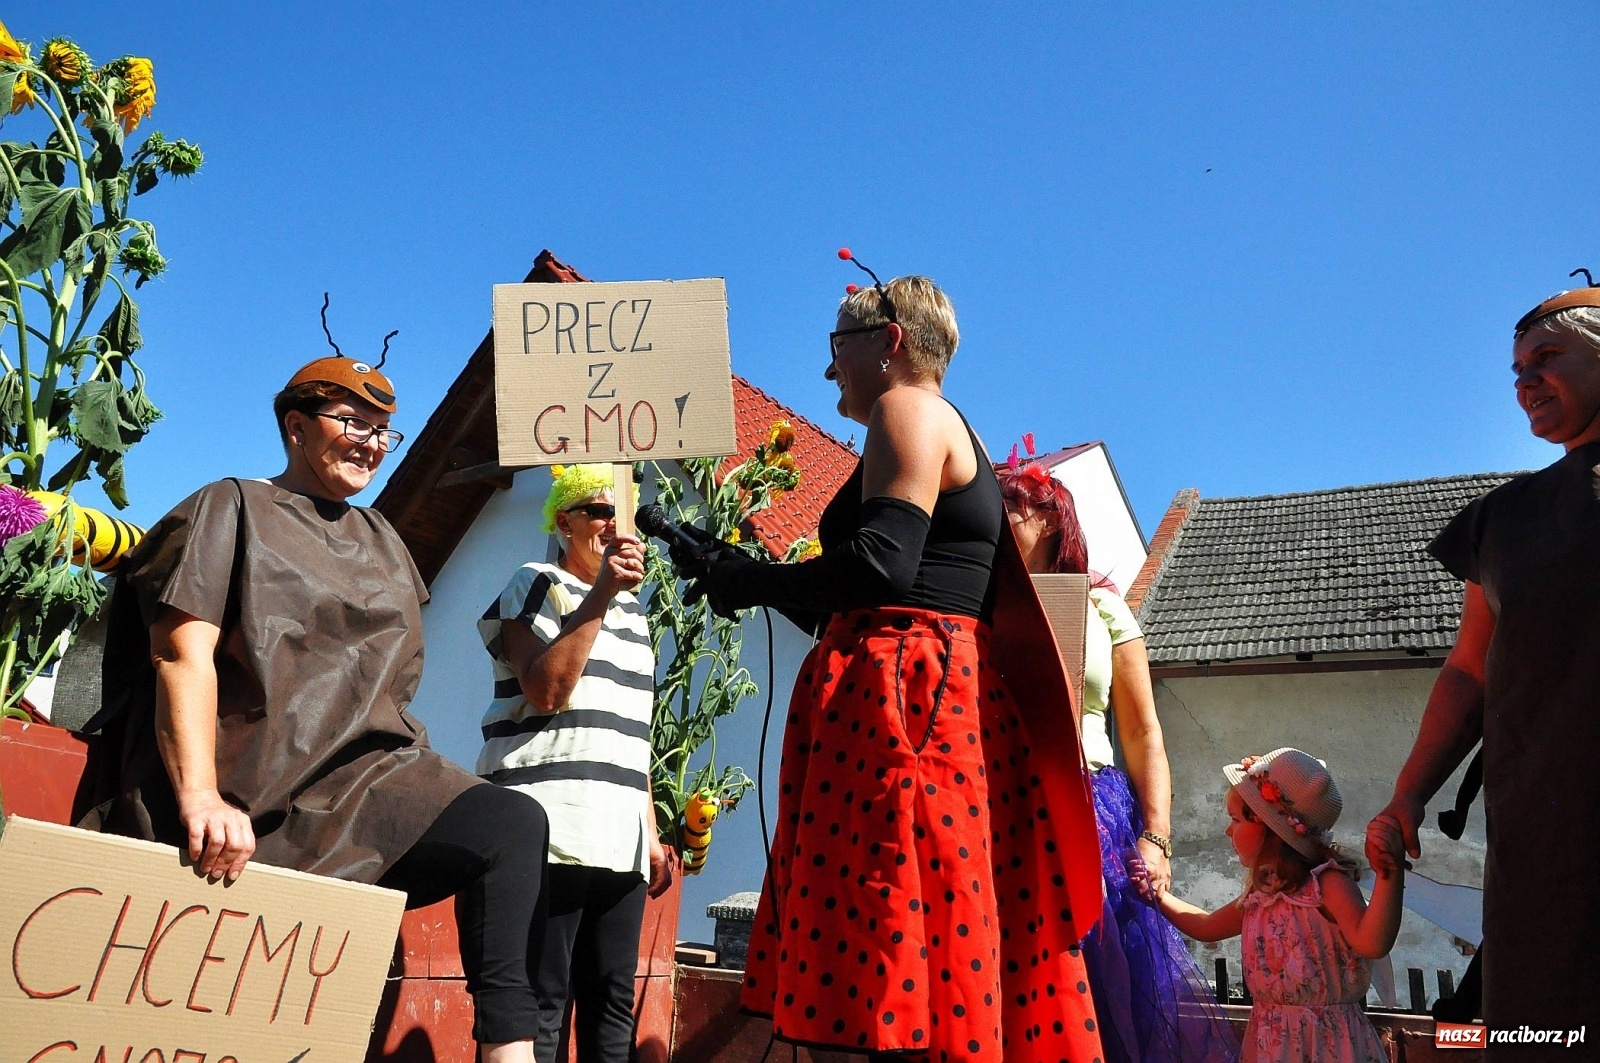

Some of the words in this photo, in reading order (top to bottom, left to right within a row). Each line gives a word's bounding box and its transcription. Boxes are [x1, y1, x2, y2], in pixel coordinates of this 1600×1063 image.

[522, 299, 652, 355] PRECZ
[587, 362, 617, 399] Z
[12, 886, 351, 1026] CHCEMY
